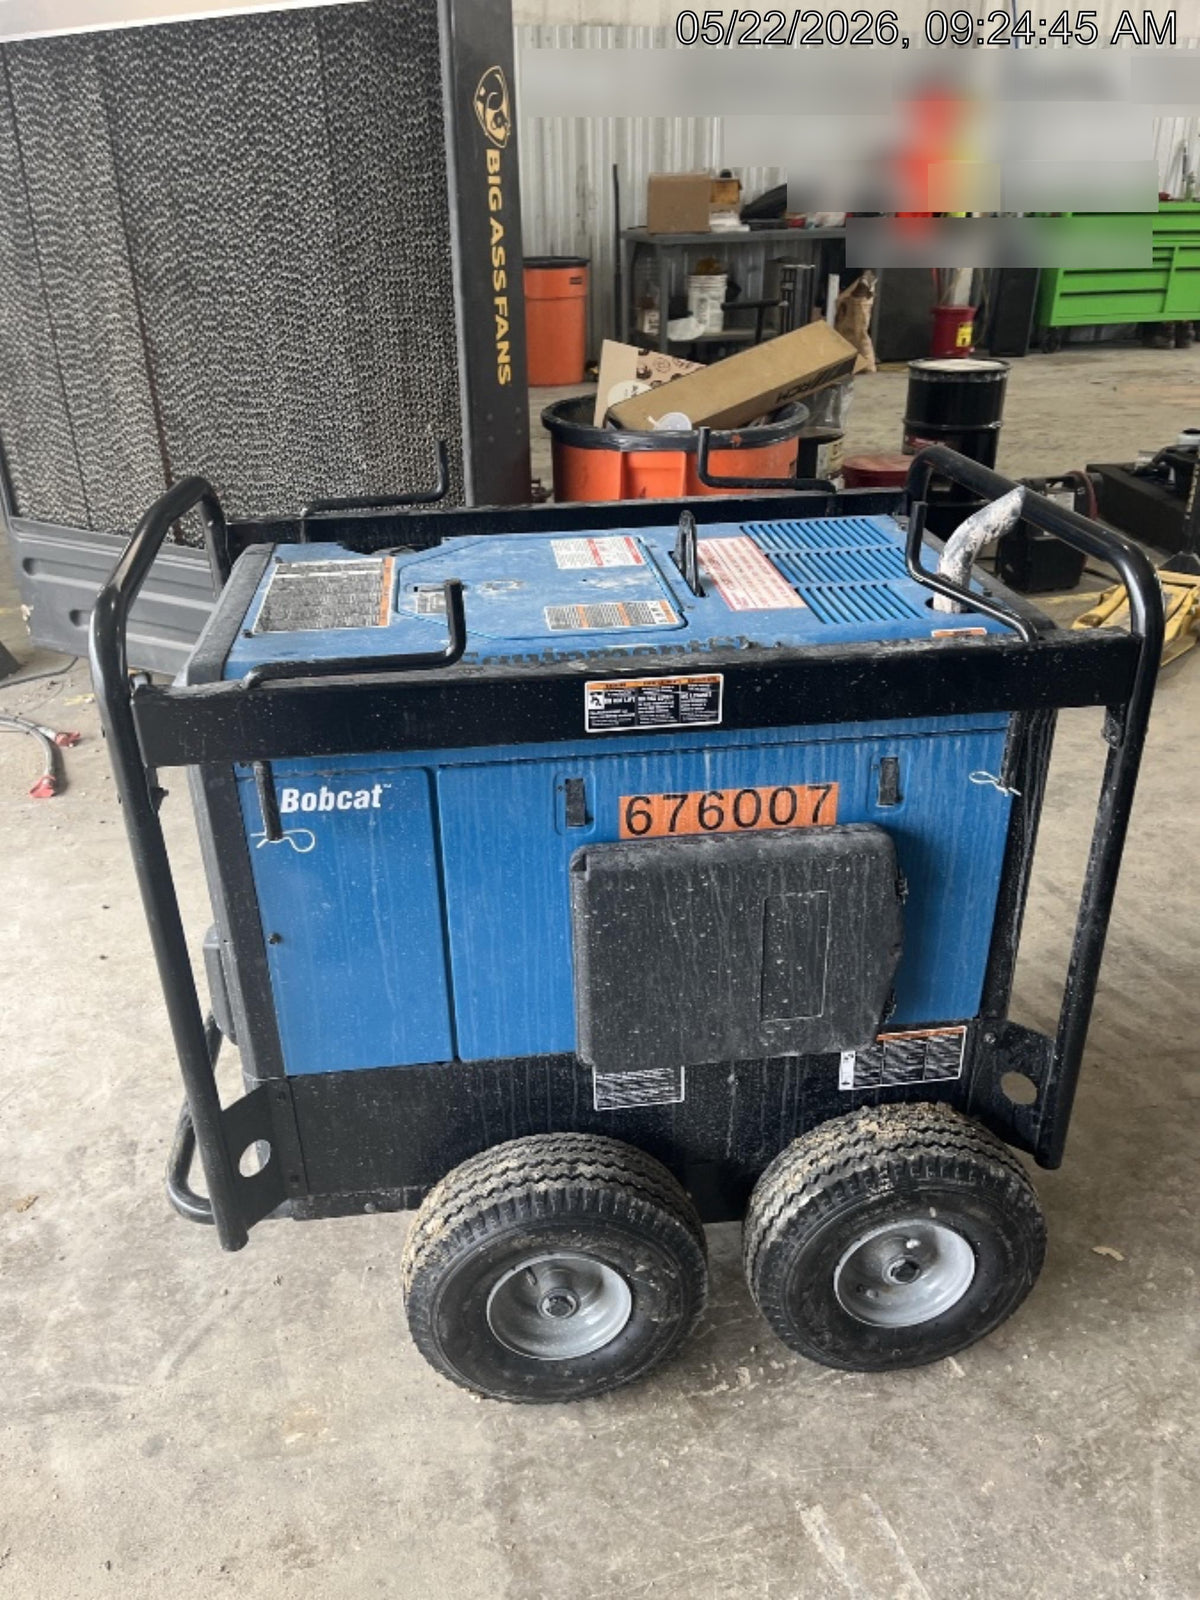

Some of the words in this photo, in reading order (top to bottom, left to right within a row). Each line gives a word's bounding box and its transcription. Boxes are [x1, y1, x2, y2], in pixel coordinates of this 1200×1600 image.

[486, 149, 502, 212] BIG
[490, 217, 507, 292] ASS
[494, 297, 511, 385] FANS
[625, 784, 832, 836] 676007
